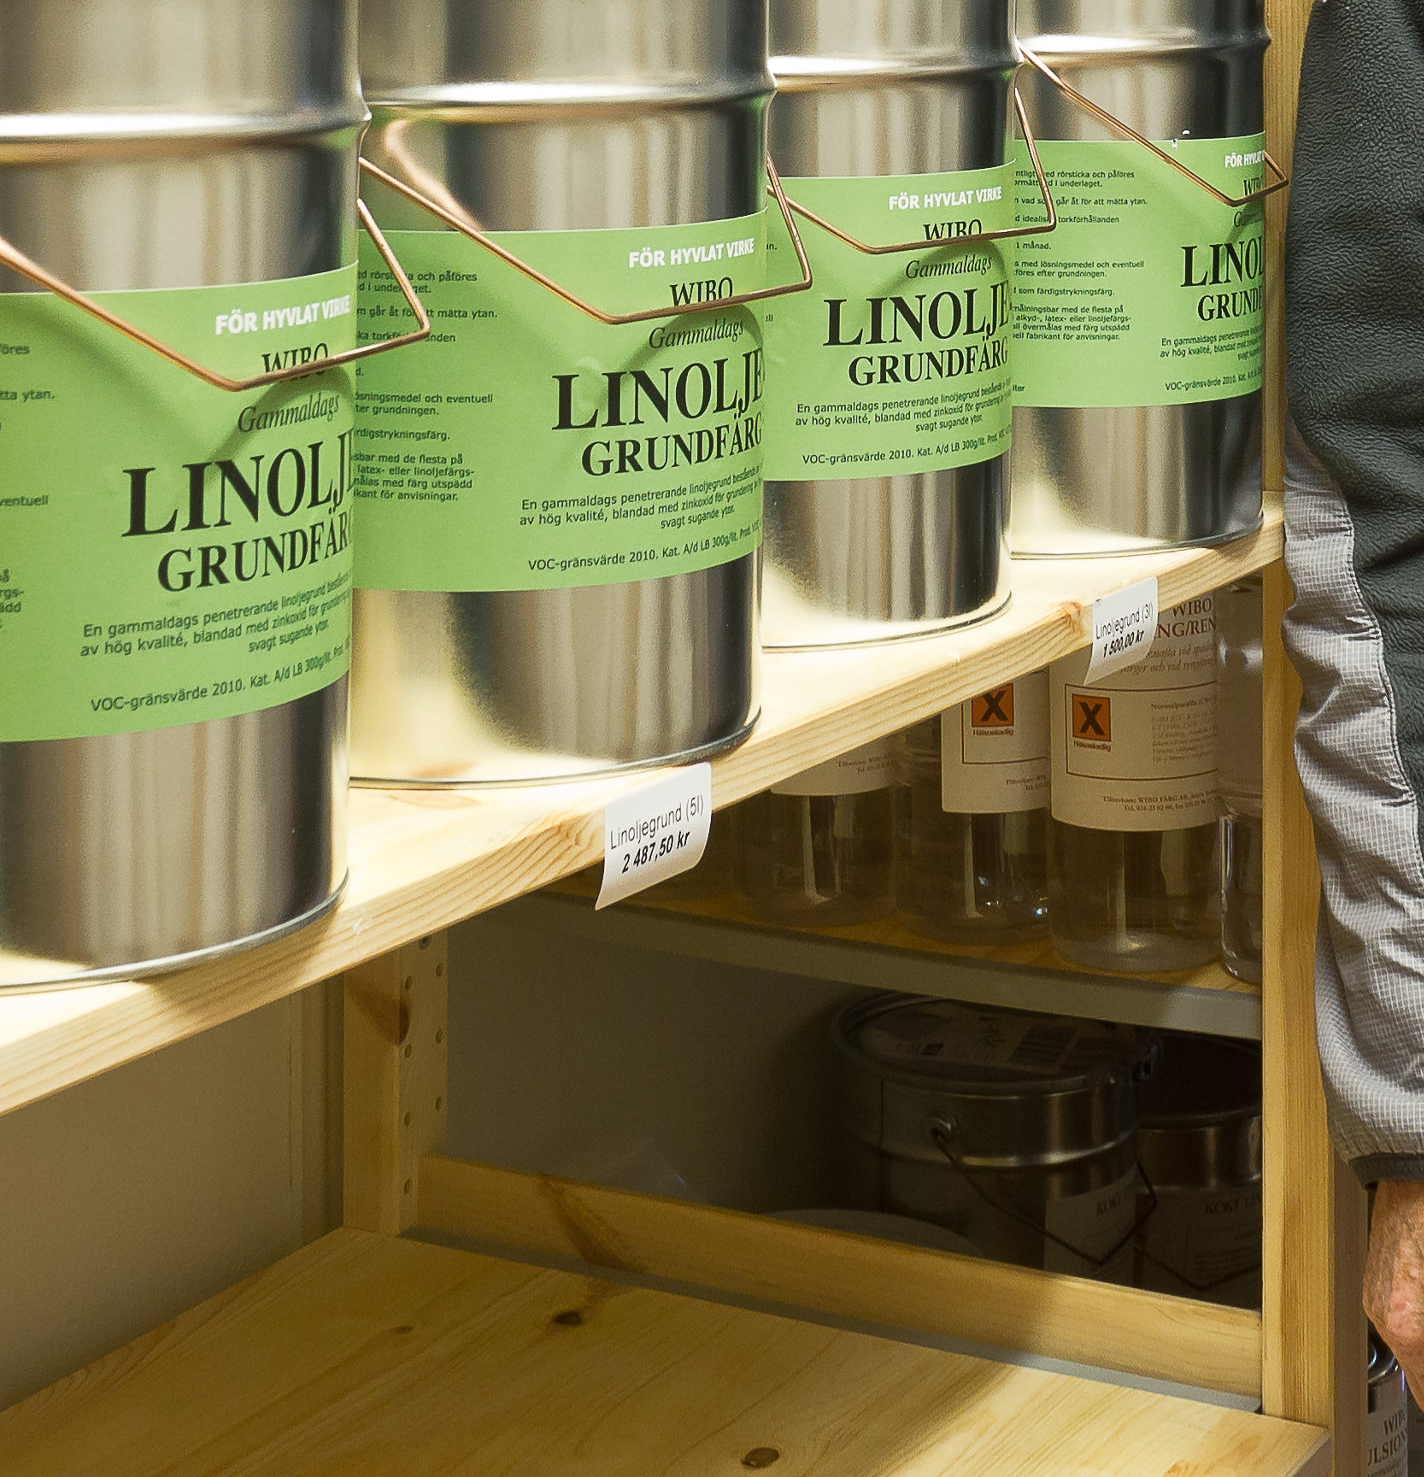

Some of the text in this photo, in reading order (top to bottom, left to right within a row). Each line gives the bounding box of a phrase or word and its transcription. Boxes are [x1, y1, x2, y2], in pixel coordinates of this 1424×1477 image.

[1224, 152, 1242, 168] FÖR
[1108, 170, 1134, 180] påföres
[889, 186, 1002, 210] FÖR HYVLAT VIRKE
[923, 218, 982, 241] WIBO
[628, 237, 754, 268] FÖR HYVLAT VIRKE
[418, 270, 477, 283] och påföres
[905, 253, 992, 279] Gammaldags
[669, 276, 733, 309] WIBO
[215, 294, 351, 335] FÖR HYVLAT VIRKE
[437, 309, 498, 319] mätta ytan.
[648, 318, 744, 350] Gammaldags
[261, 342, 329, 381] WIBO
[848, 334, 1008, 386] GRUNDFÄRG
[425, 394, 493, 404] och eventuell
[238, 391, 339, 433] Gammaldags
[372, 406, 439, 417] grundningen.
[581, 410, 762, 477] GRUNDFÄRG
[378, 454, 447, 465] med flesta
[802, 450, 885, 465] VOC-gränsvärde
[398, 491, 458, 502] anvisningar.
[407, 479, 472, 490] färg utspädd
[522, 486, 686, 511] En gammaldags penetrerande
[519, 502, 678, 526] av hög kvalité, blandad med
[660, 516, 685, 529] svagt
[528, 549, 658, 571] VOC-gränsvärde 2010.
[82, 599, 278, 637] En gammaldags penetrerande
[1172, 598, 1212, 617] WIBO
[1096, 607, 1140, 640] Linoljegrund
[80, 619, 269, 657] av hög kvalité, blandad med
[249, 636, 276, 652] svagt
[1136, 630, 1144, 642] kr
[91, 678, 245, 712] VOC-gränsvärde 2010.
[610, 794, 704, 850] Linoljegrund (5l)
[622, 831, 690, 874] 2 487,50 kr
